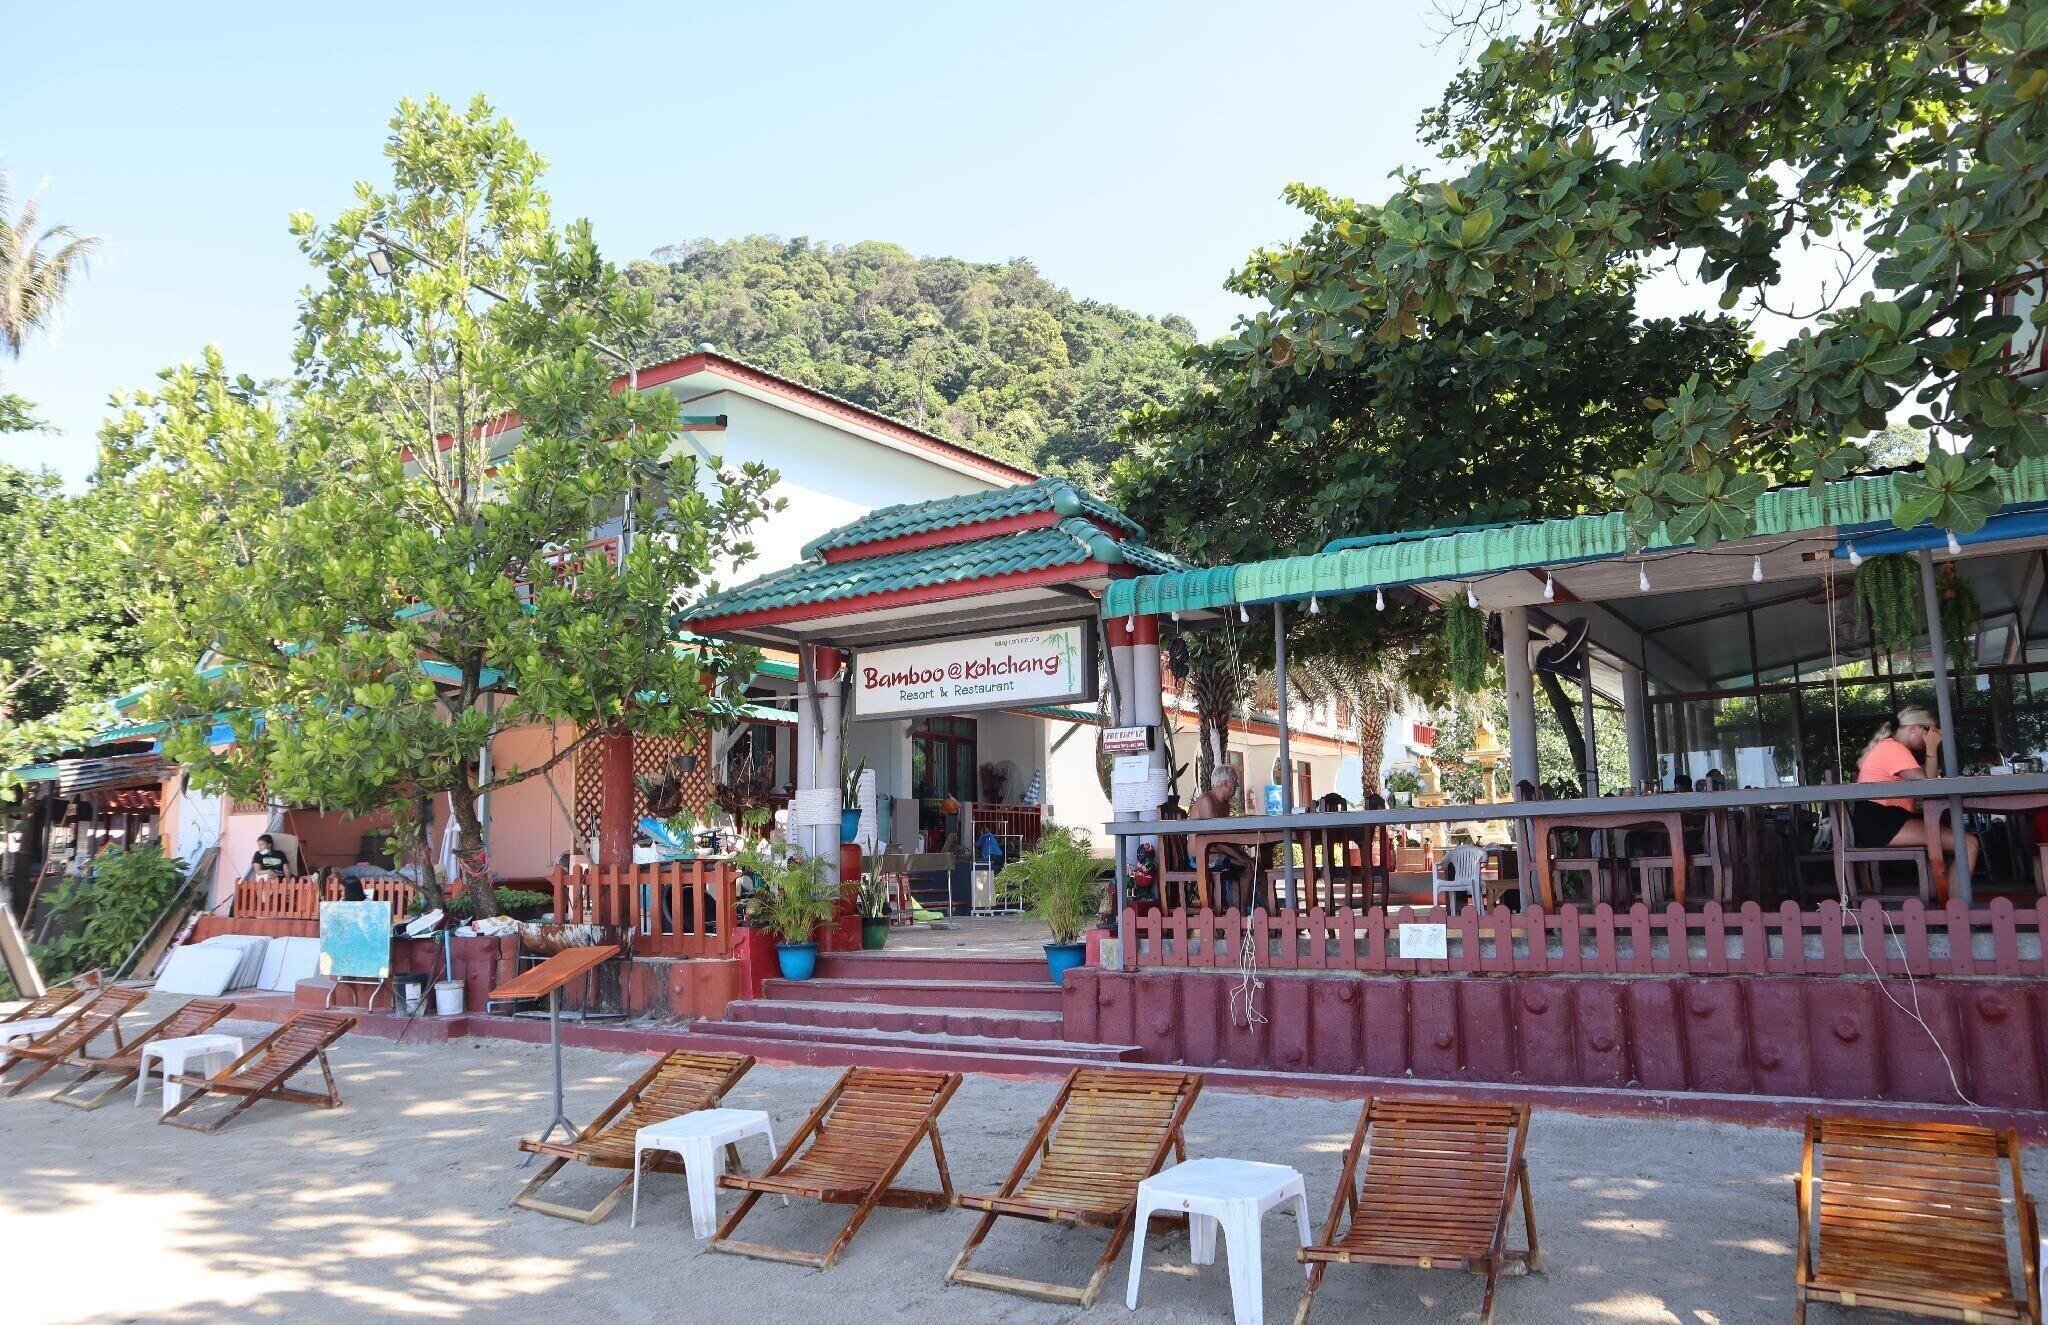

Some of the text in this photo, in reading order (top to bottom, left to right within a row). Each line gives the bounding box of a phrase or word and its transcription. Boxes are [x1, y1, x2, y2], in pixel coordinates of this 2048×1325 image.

[863, 666, 944, 690] Bamboo
[965, 654, 1060, 680] Kohchang
[899, 680, 1015, 702] Resort & Restaurant
